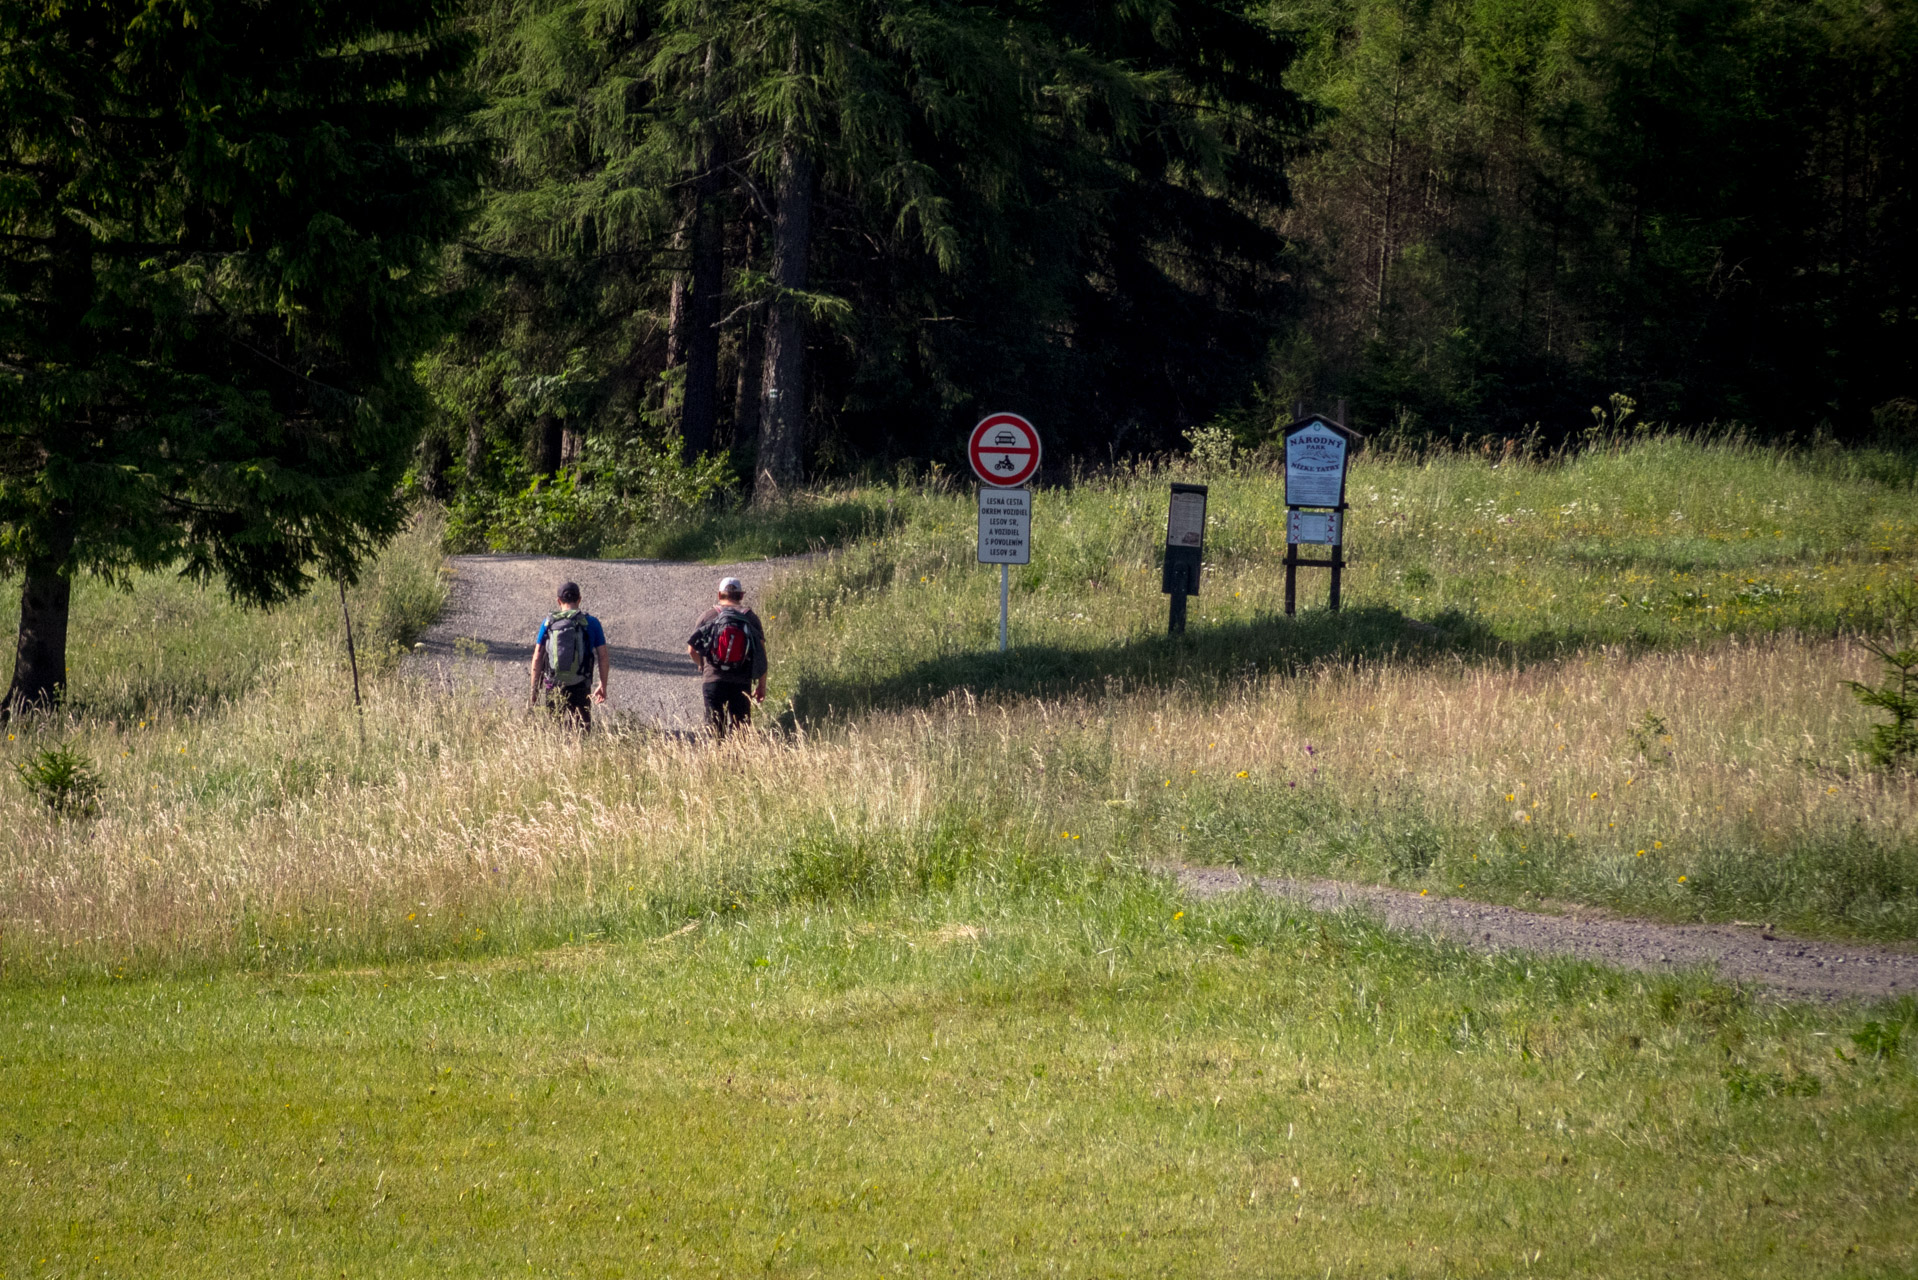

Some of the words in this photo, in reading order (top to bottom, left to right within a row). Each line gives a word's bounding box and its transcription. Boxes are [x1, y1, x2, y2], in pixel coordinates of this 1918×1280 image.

[1290, 436, 1343, 449] NÁRODNÝ
[1291, 462, 1315, 472] NÍZKE
[1316, 464, 1340, 472] TATRY
